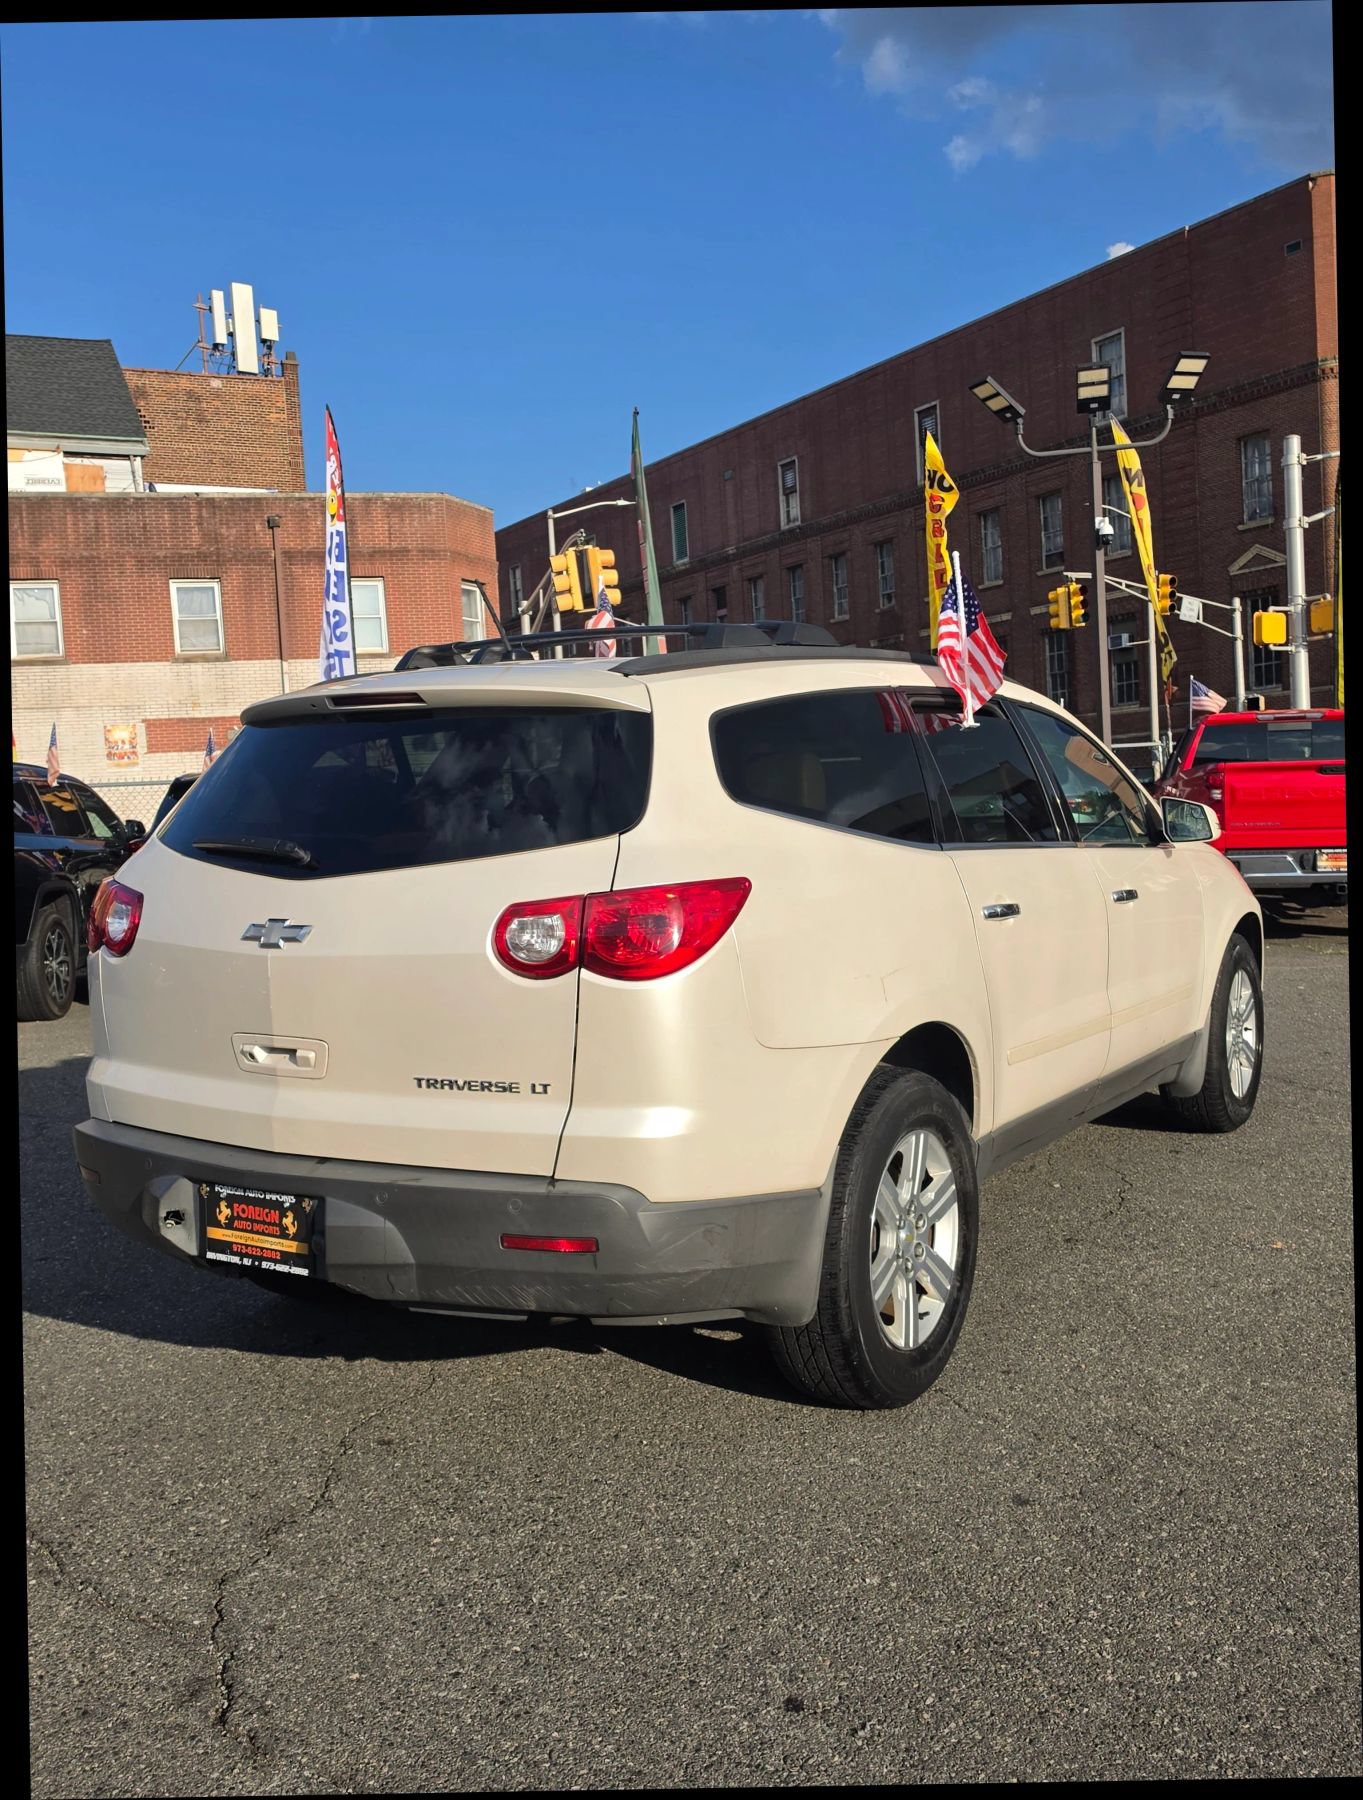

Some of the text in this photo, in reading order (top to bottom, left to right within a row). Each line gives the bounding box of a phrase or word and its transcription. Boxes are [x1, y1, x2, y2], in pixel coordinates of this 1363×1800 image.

[414, 1077, 551, 1094] TRAVERSE LT
[245, 1189, 264, 1199] AUTO
[233, 1203, 279, 1223] FOREIGN
[233, 1220, 280, 1235] AUTO IMPORTS
[243, 1257, 252, 1266] NJ
